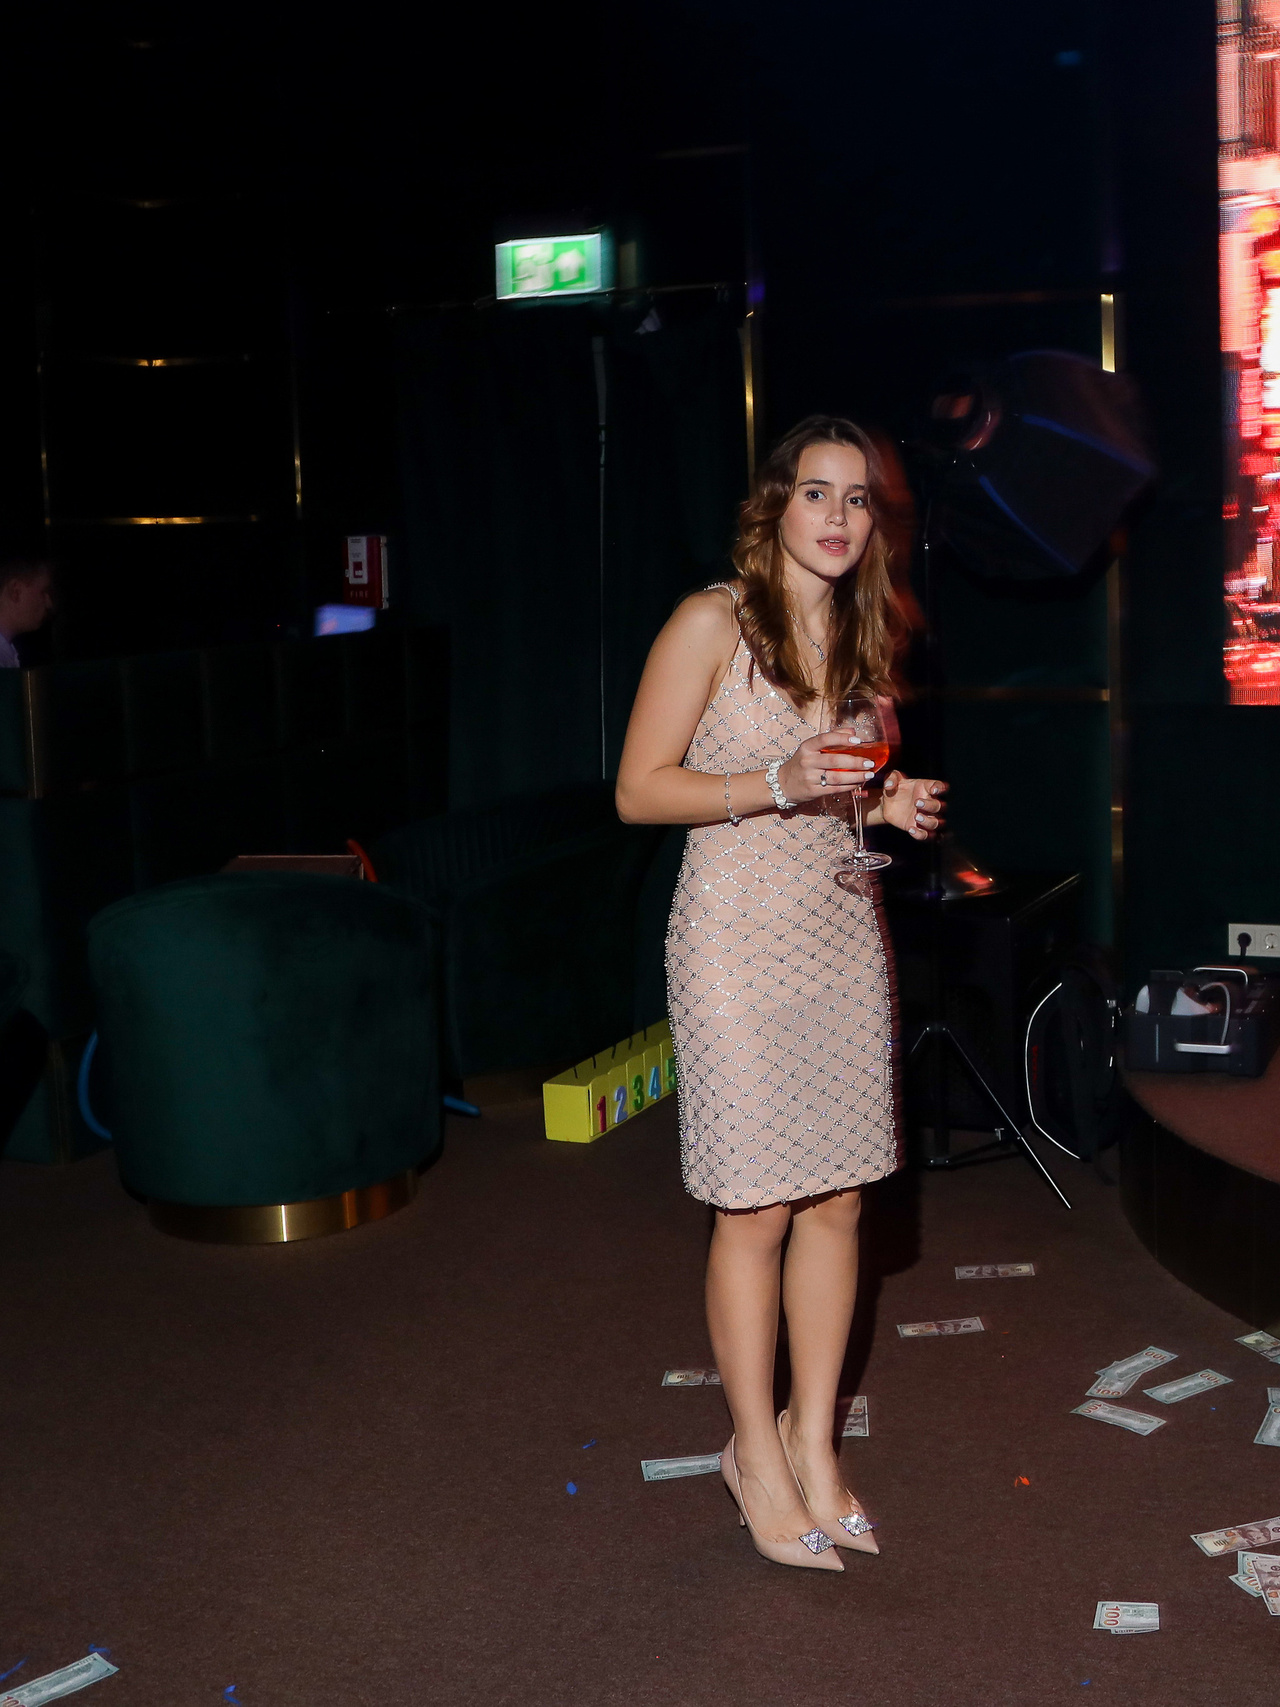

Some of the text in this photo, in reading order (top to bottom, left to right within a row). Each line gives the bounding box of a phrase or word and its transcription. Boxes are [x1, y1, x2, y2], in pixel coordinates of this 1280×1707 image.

[350, 590, 369, 598] FIRE
[596, 1056, 677, 1133] 1 2 3 4 5
[1144, 1351, 1167, 1361] 100
[1096, 1388, 1122, 1396] 100
[1104, 1605, 1120, 1626] 100
